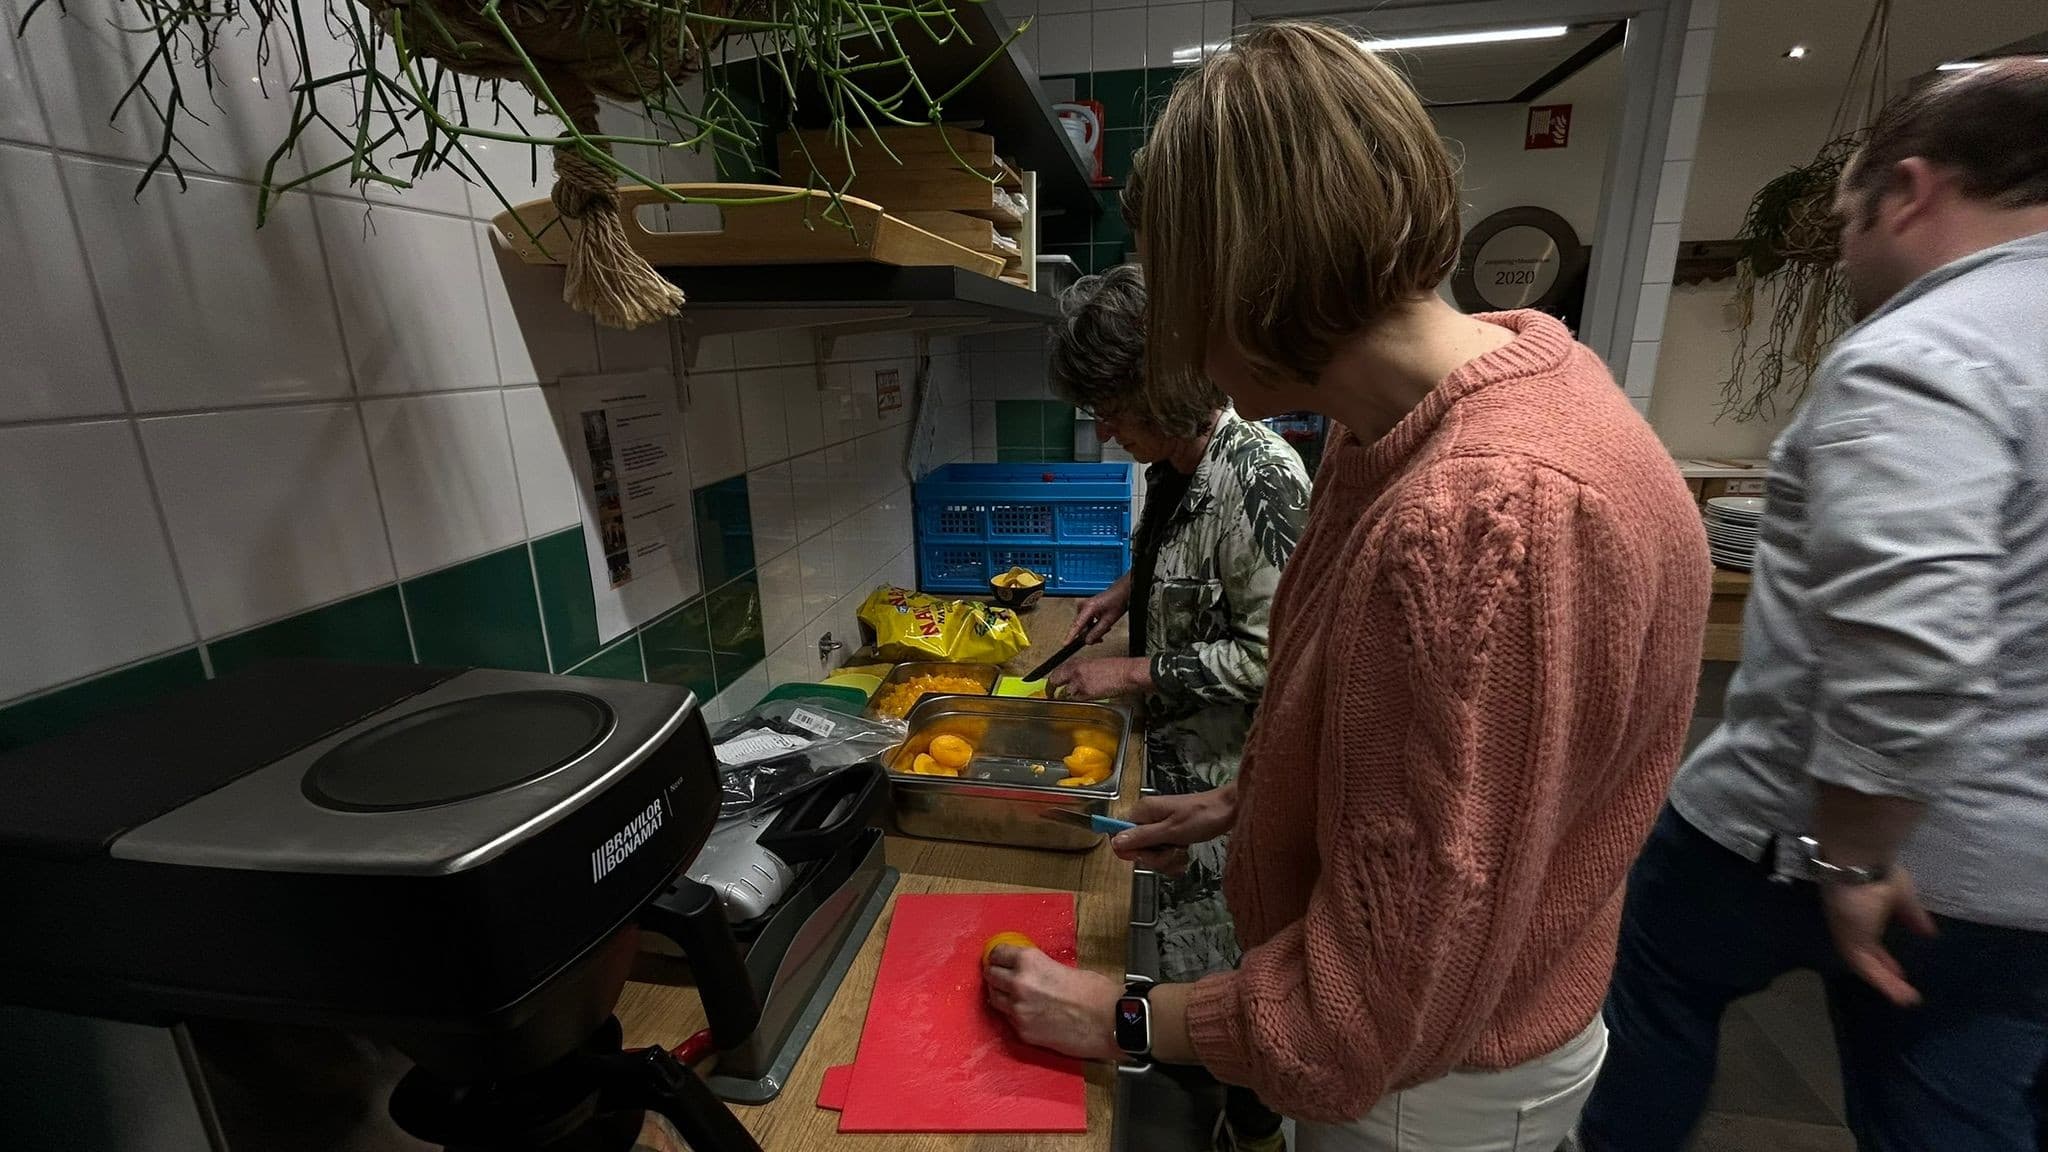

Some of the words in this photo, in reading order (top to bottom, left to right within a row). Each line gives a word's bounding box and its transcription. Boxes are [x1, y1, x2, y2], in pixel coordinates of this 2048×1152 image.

[1495, 270, 1535, 285] 2020
[605, 798, 662, 857] BRAVILOR
[606, 811, 663, 873] BONAMAT
